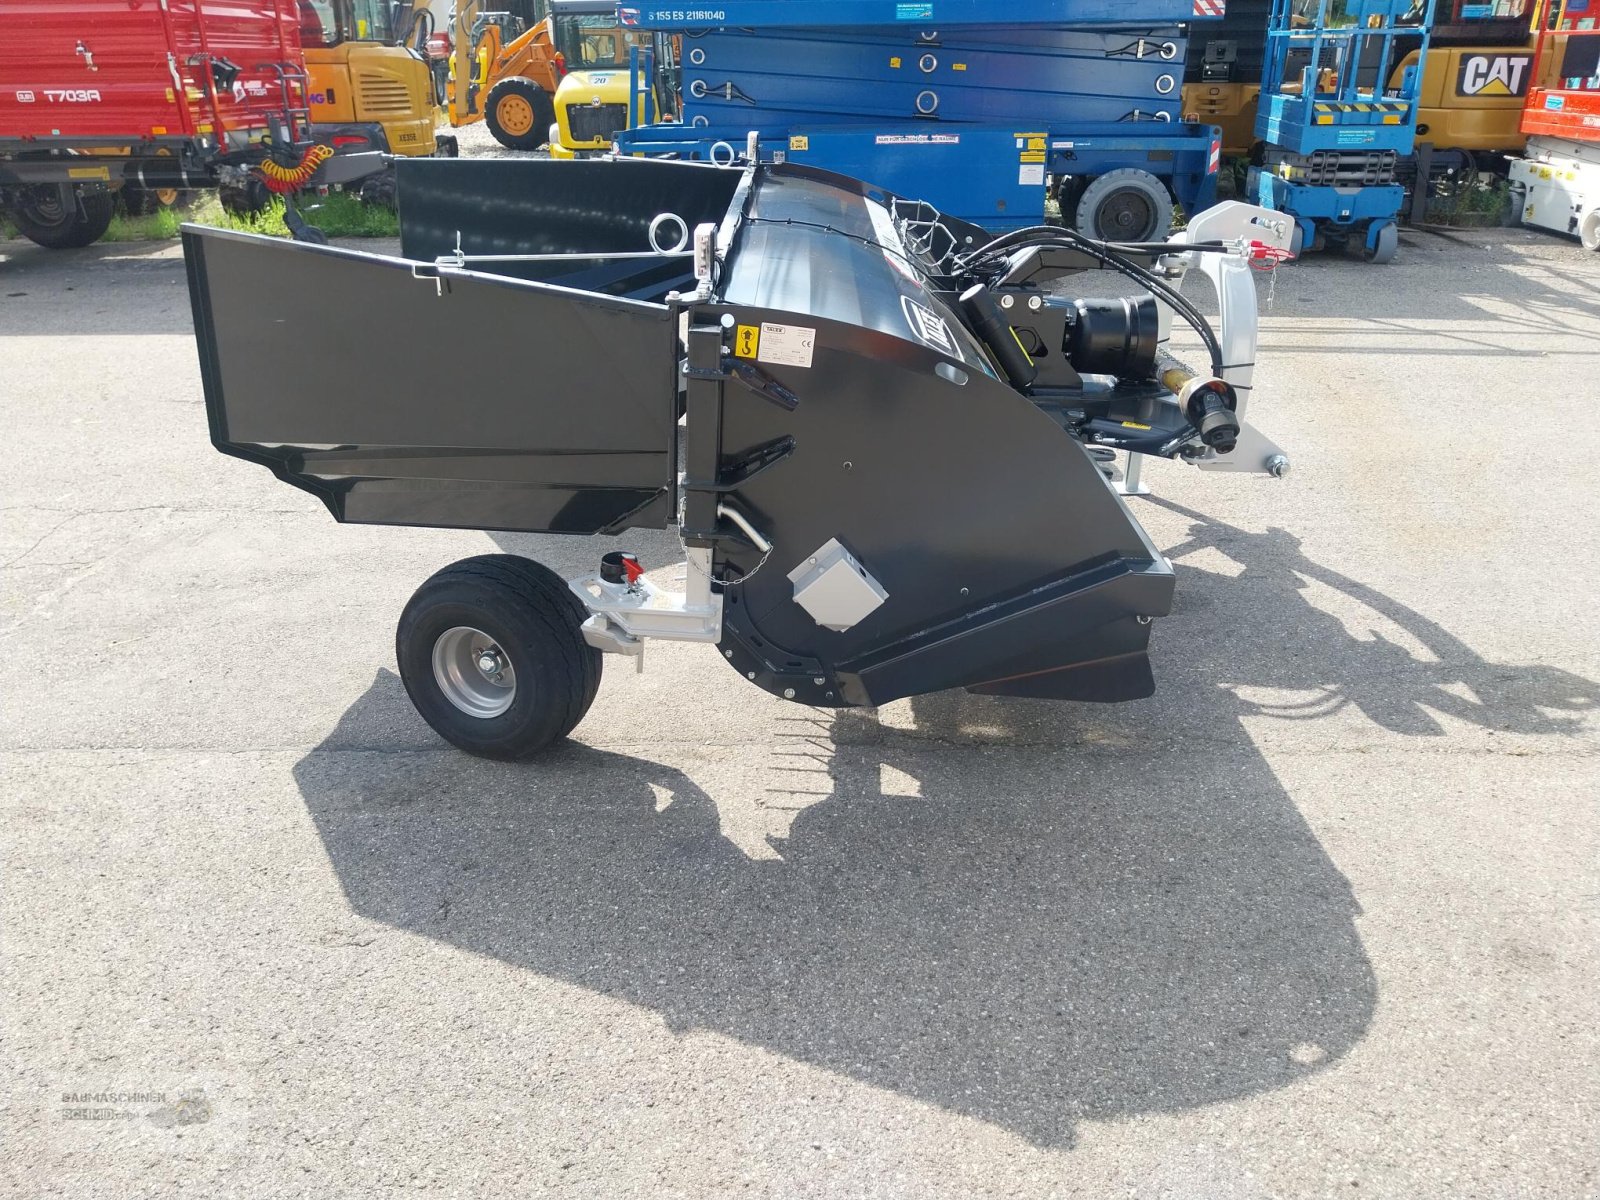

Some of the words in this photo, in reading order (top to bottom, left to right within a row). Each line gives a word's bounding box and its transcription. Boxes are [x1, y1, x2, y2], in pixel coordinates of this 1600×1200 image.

[656, 11, 671, 20] 155
[672, 11, 684, 20] ES
[1463, 56, 1529, 95] CAT
[43, 90, 101, 102] T703A
